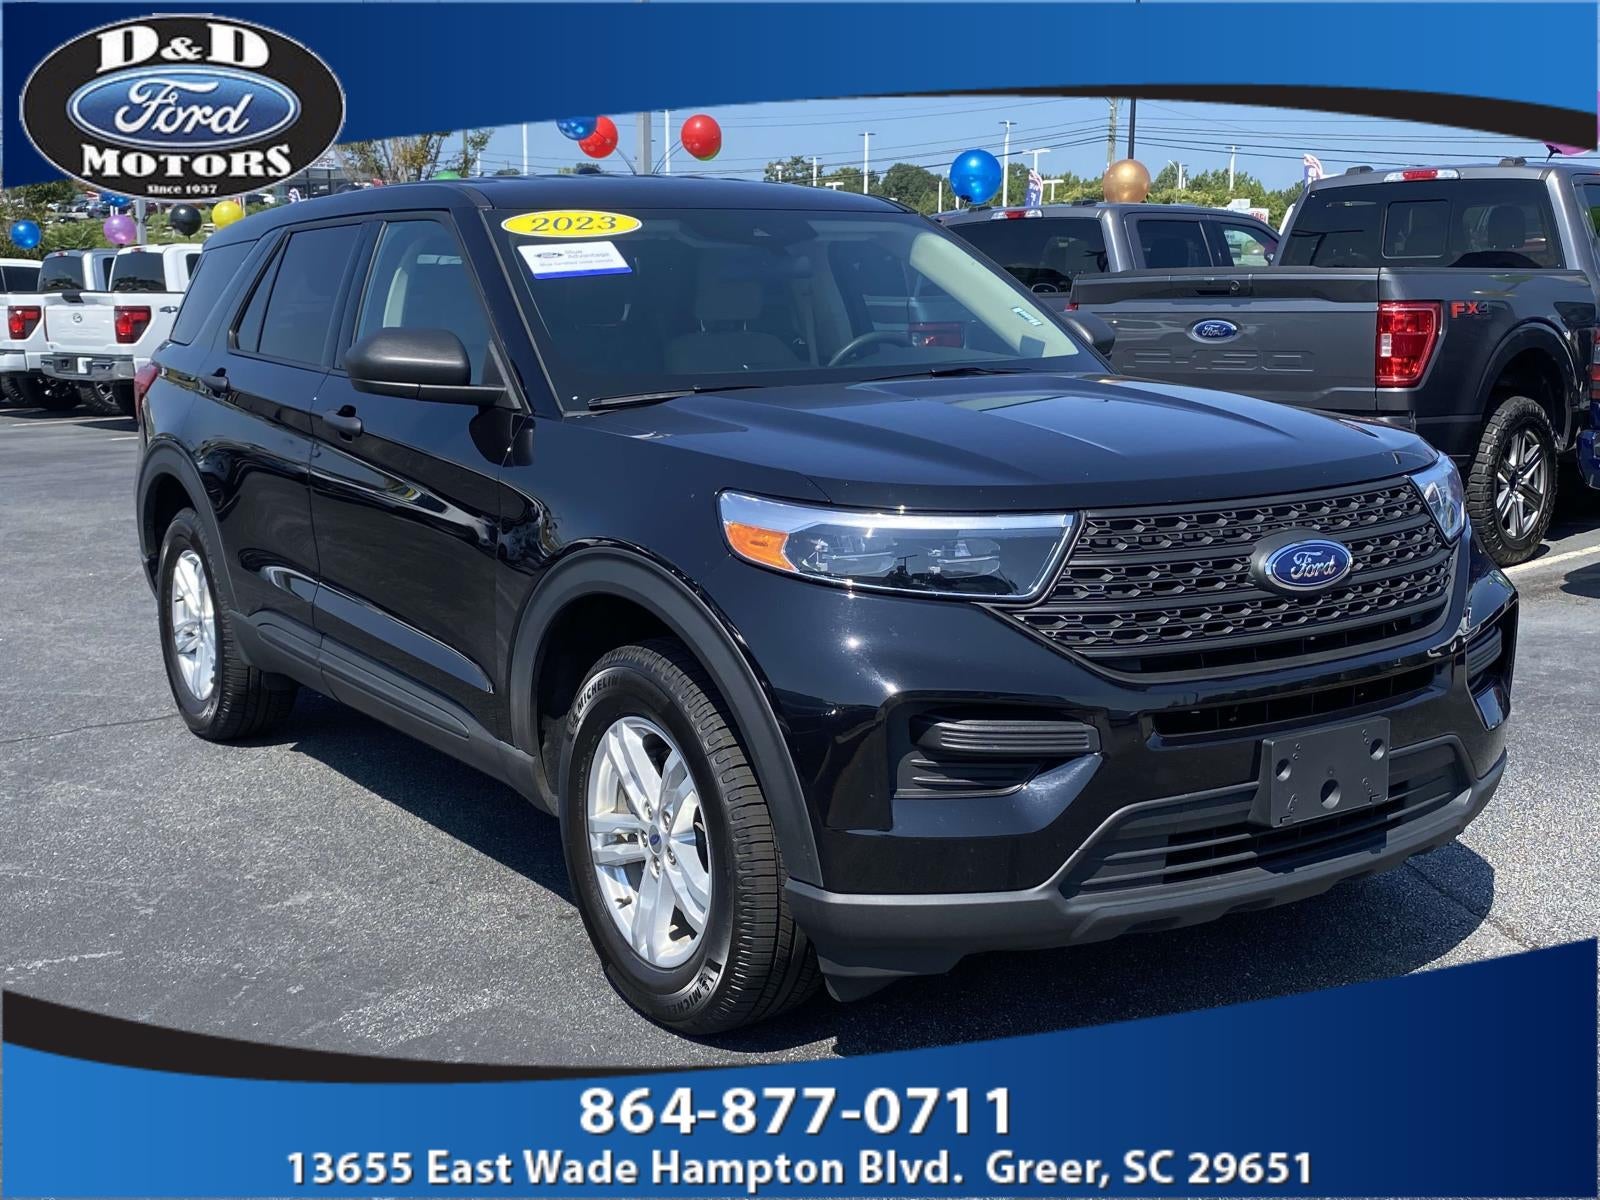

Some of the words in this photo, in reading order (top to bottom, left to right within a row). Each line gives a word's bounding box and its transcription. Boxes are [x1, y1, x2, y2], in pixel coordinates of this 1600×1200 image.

[531, 215, 617, 232] 2023
[1201, 323, 1228, 337] Ford
[1290, 550, 1337, 580] Ford
